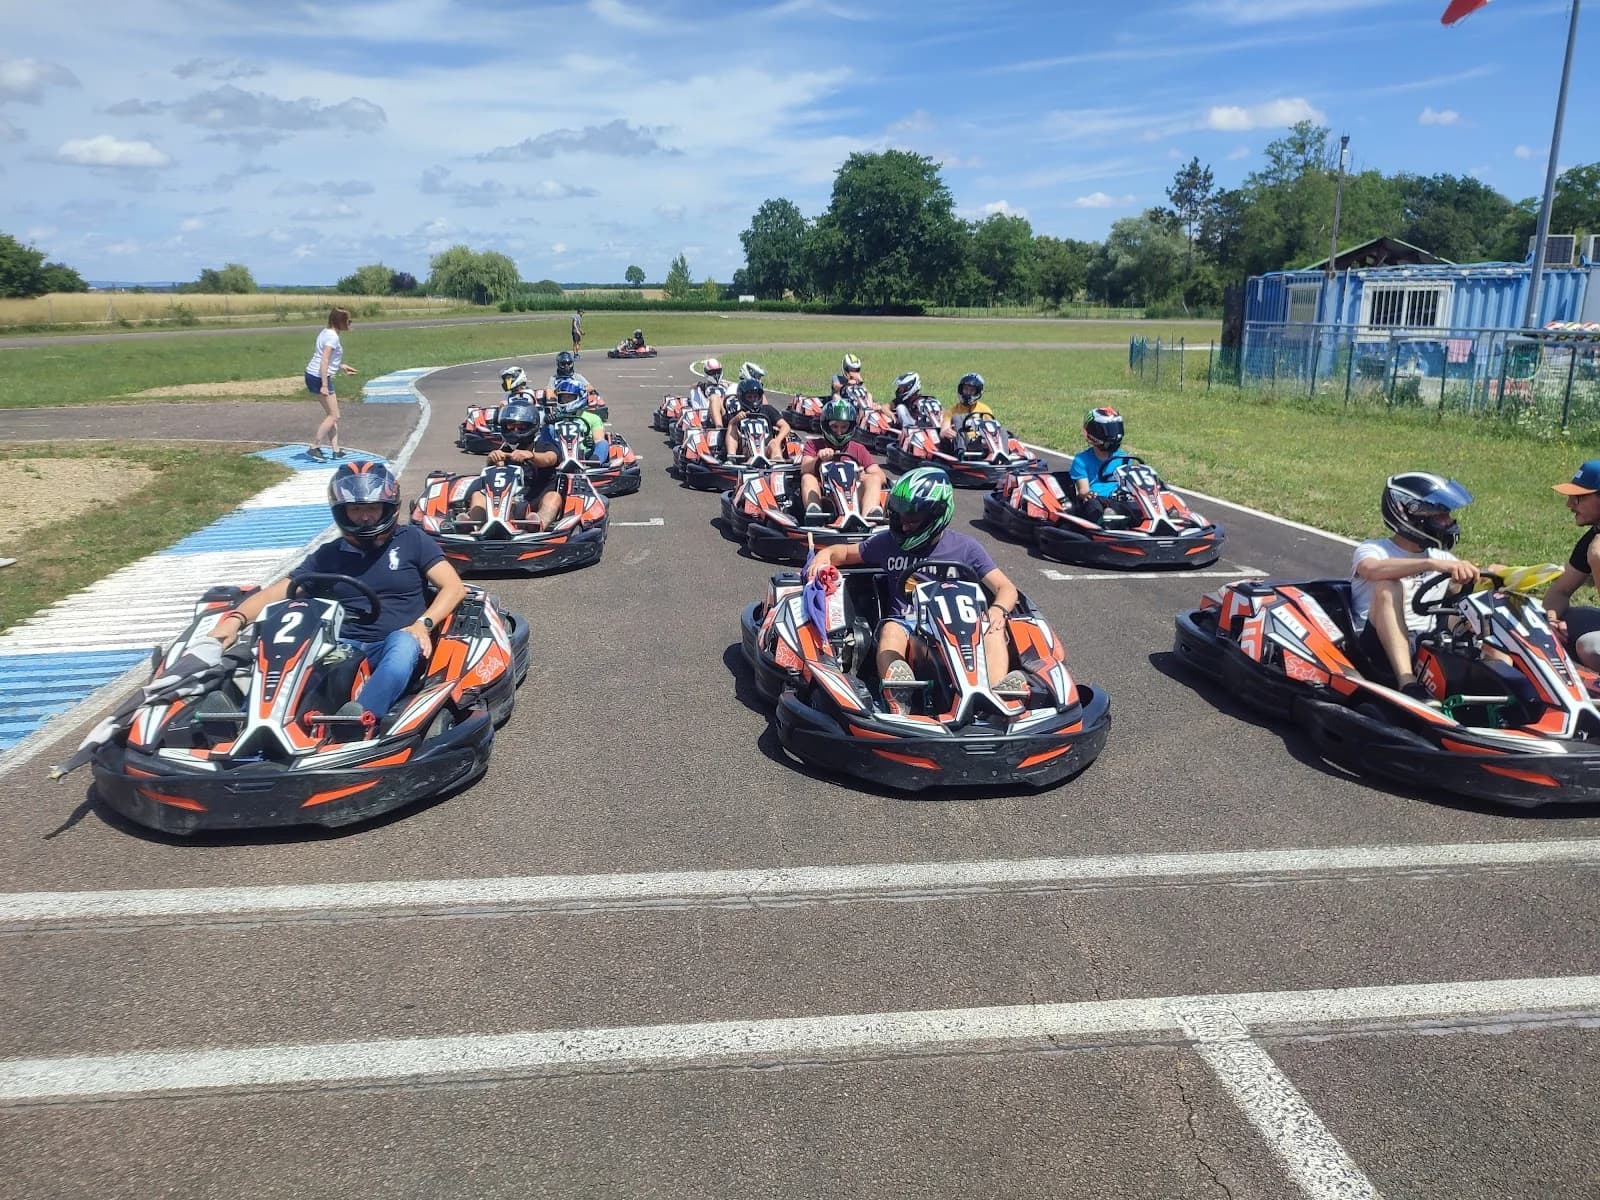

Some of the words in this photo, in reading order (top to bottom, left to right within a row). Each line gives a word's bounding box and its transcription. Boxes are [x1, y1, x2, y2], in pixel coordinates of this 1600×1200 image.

[561, 423, 578, 437] 12
[747, 422, 764, 435] 10
[493, 472, 506, 488] 5
[838, 467, 848, 483] 1
[1129, 470, 1155, 486] 15
[934, 595, 977, 624] 16
[273, 611, 304, 643] 2
[1495, 605, 1553, 637] 14
